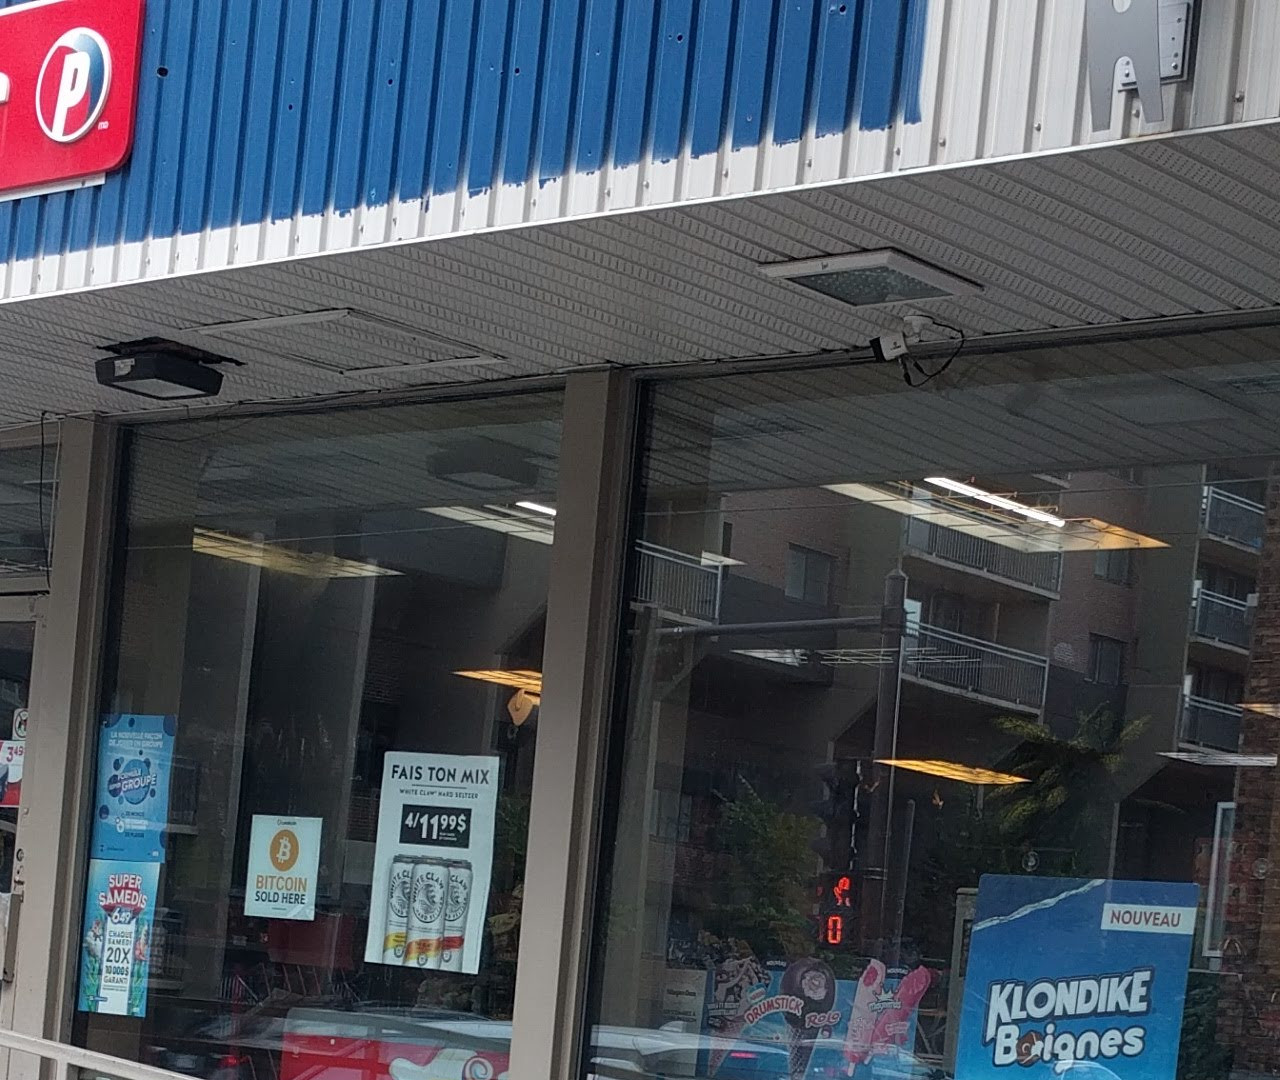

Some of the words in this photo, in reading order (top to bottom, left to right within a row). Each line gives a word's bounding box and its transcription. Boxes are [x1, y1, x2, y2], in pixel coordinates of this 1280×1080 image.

[121, 774, 157, 791] GROUPE
[391, 764, 423, 781] FAIS
[427, 766, 457, 783] TON
[460, 769, 490, 785] MIX
[109, 874, 142, 889] SUPER
[255, 875, 308, 893] BITCOIN
[99, 889, 148, 909] SAMEDIS
[255, 890, 280, 903] SOLD
[281, 892, 306, 905] HERE
[1110, 909, 1182, 928] NOUVEAU
[106, 947, 131, 964] 20X
[745, 995, 804, 1024] DRUMSTICK
[985, 970, 1151, 1042] KLONDIKE
